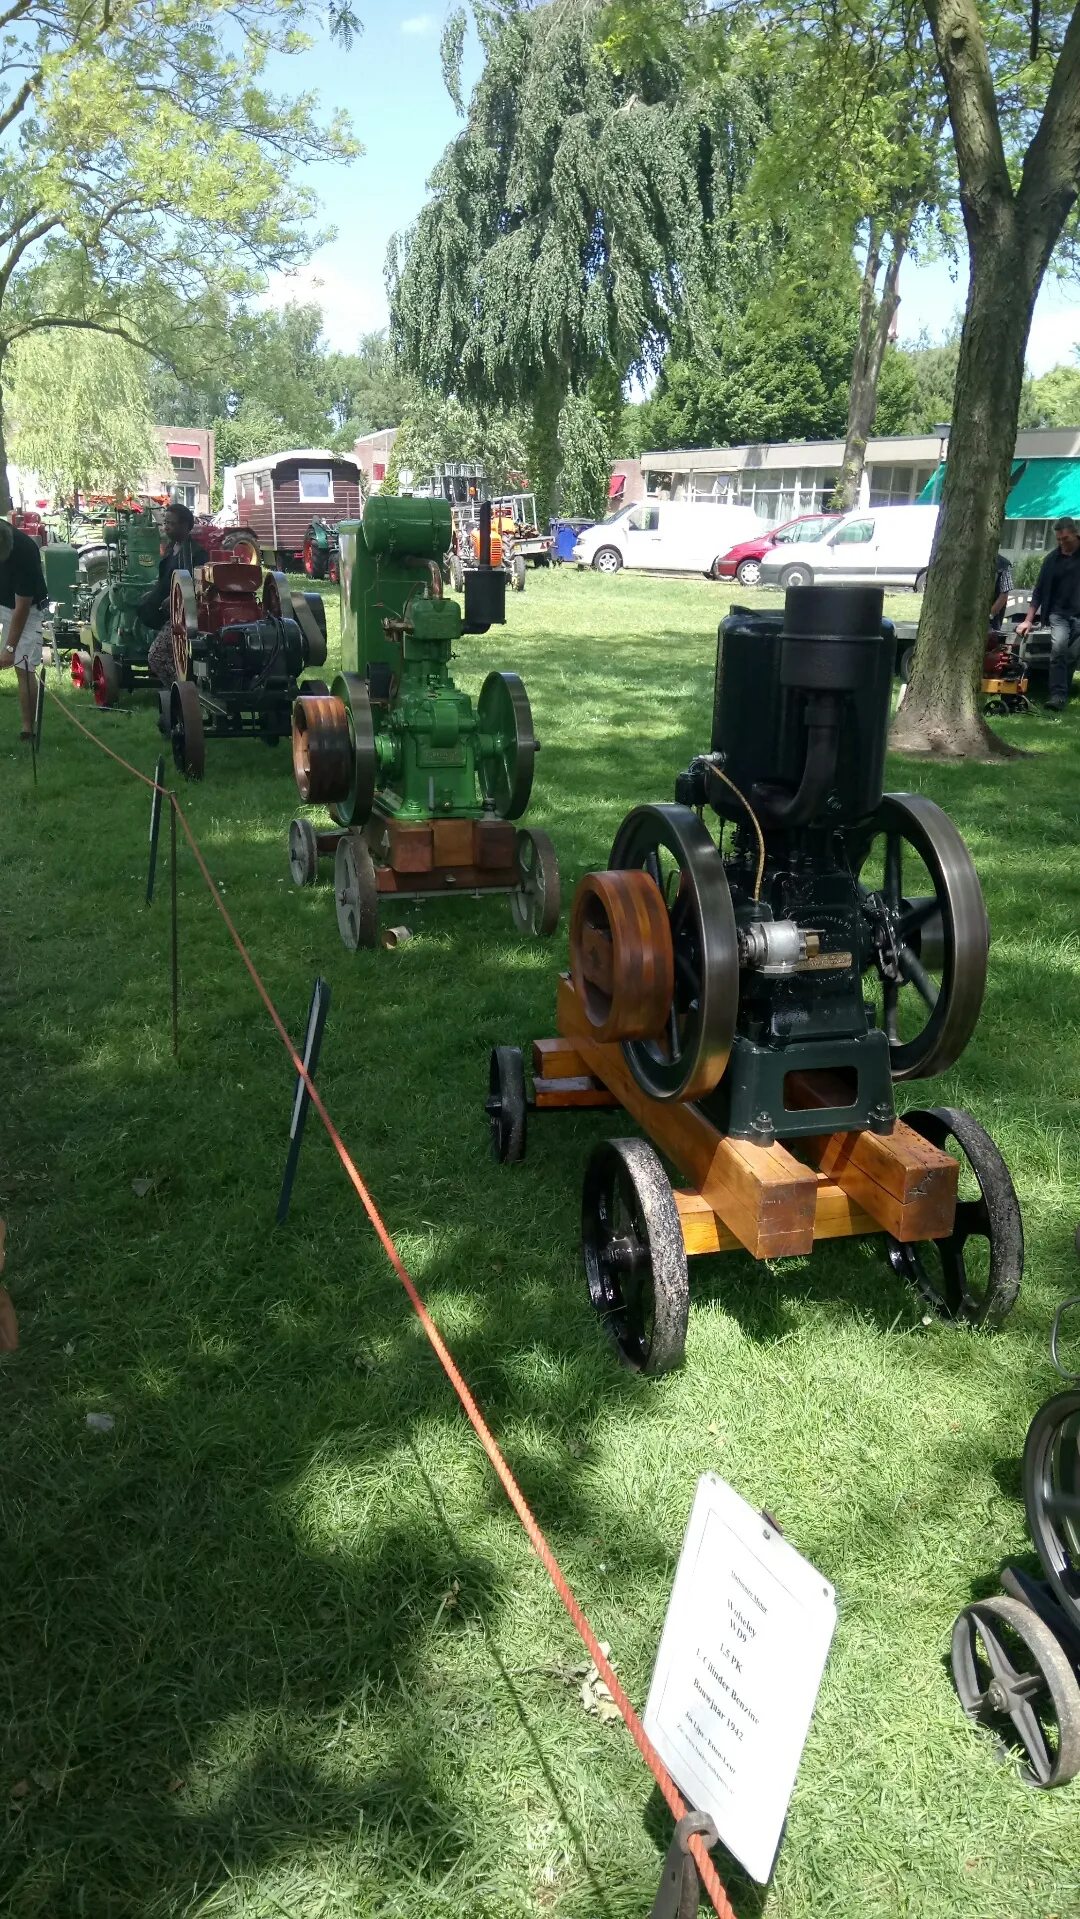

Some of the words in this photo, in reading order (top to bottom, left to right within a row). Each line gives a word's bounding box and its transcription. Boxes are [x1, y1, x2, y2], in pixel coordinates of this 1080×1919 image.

[730, 1618, 747, 1643] WD9
[731, 1655, 743, 1674] PK
[693, 1677, 726, 1720] Bouwjaar
[726, 1718, 744, 1741] 1942
[702, 1656, 731, 1692] Cilinder
[731, 1689, 760, 1725] Benzine
